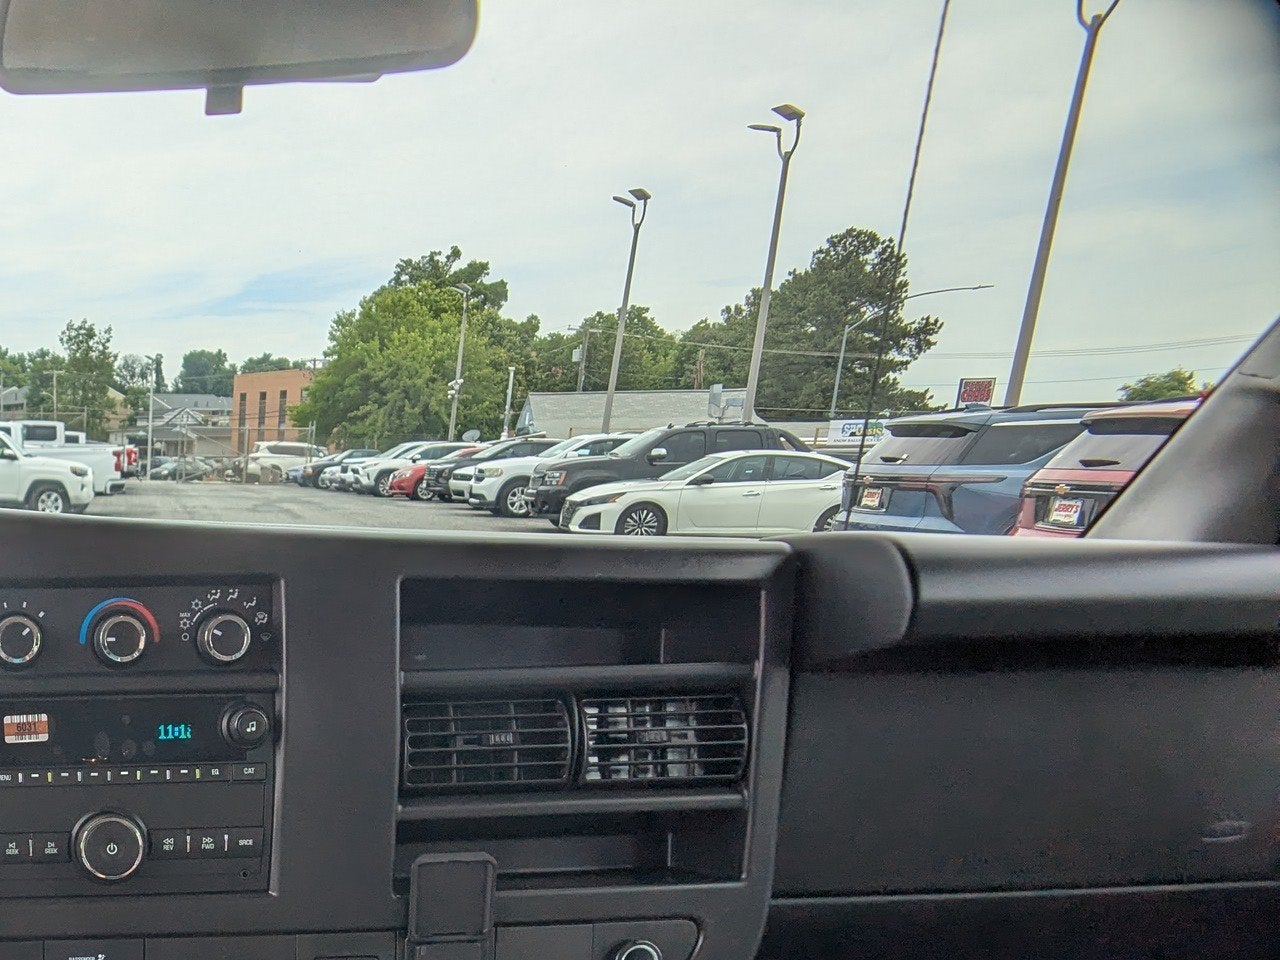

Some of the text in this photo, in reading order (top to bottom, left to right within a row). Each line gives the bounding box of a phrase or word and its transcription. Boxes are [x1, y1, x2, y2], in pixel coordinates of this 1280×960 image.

[16, 722, 37, 732] 6031
[211, 768, 220, 776] EQ
[243, 767, 256, 775] CAT
